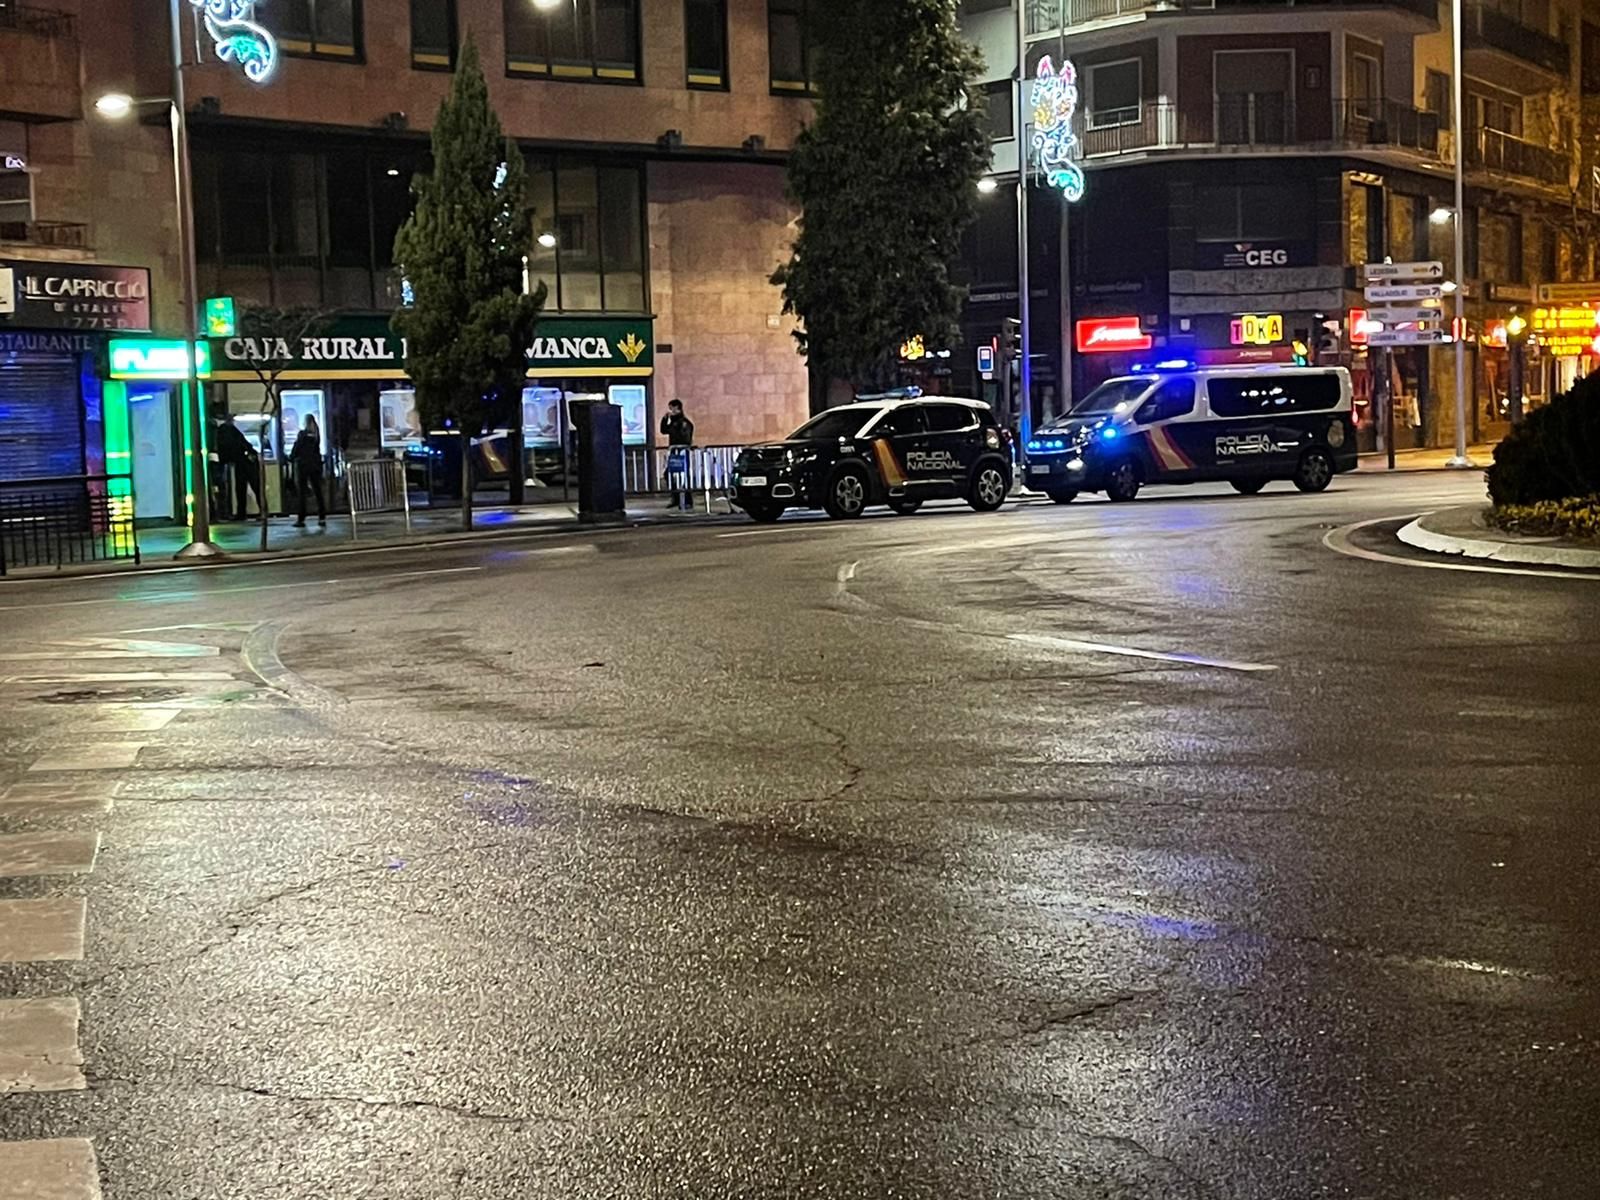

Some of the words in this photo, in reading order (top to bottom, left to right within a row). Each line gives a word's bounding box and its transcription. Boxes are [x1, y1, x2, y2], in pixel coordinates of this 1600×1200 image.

[1246, 250, 1288, 266] CEG
[26, 276, 41, 294] IL
[45, 277, 146, 298] CAPRICCIO
[1231, 319, 1281, 342] TOKA
[224, 338, 293, 361] CAJA
[301, 338, 394, 360] RURAL
[906, 450, 952, 461] POLICIA
[906, 460, 966, 471] NACIONAL
